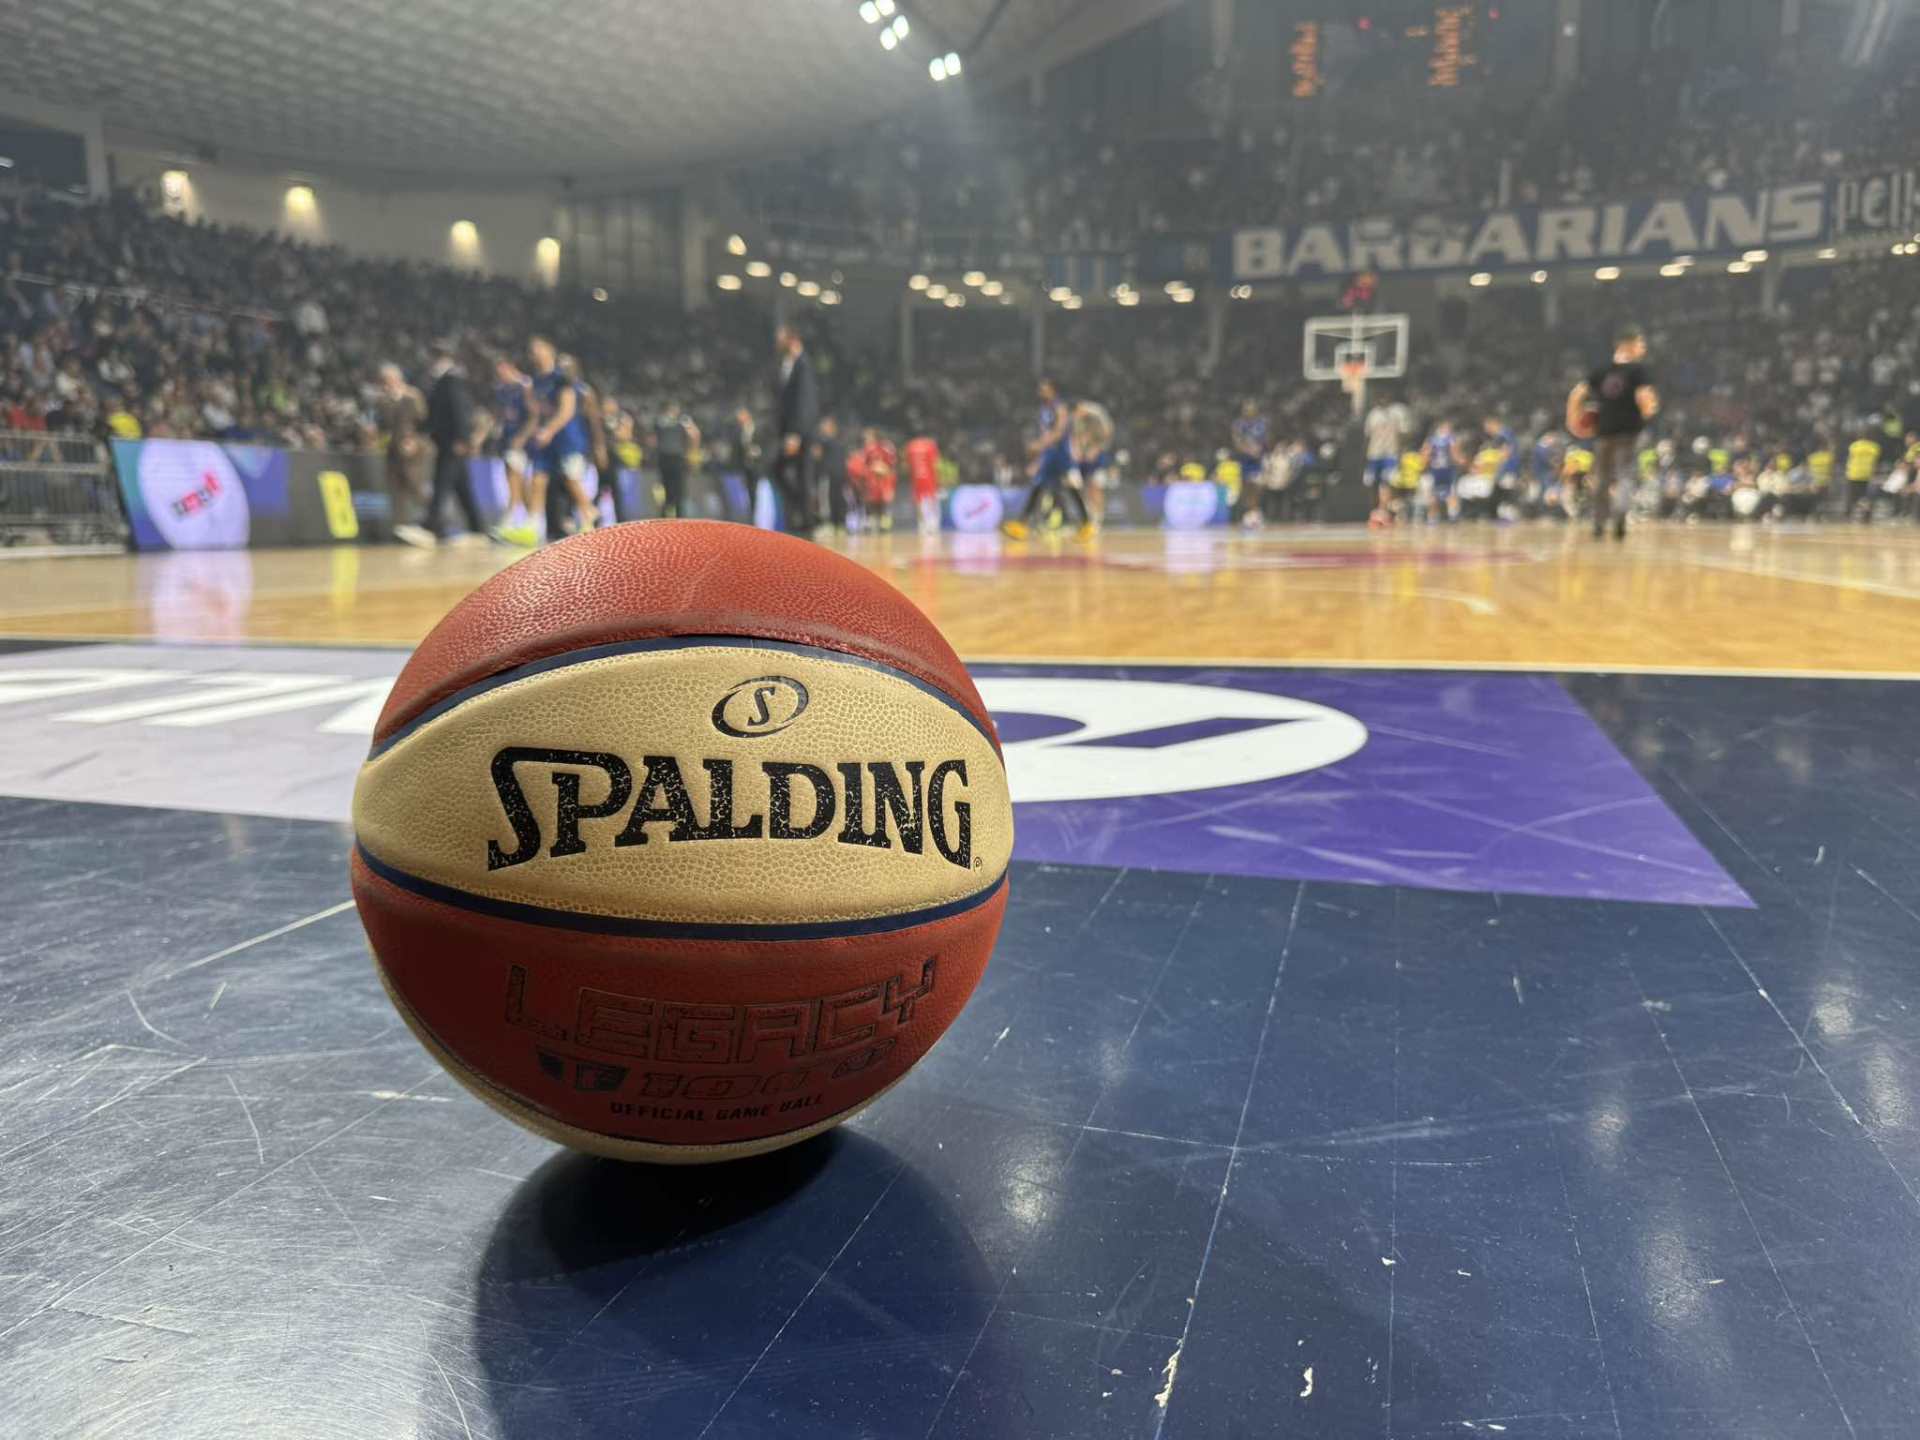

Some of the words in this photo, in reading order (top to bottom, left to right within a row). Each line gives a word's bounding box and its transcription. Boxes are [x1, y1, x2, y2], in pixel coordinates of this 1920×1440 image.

[1231, 181, 1826, 279] BARBARIANS
[746, 685, 775, 727] S
[488, 746, 971, 870] SPALDING
[504, 956, 937, 1065] LEGACY
[609, 1102, 705, 1122] OFFICIAL
[715, 1105, 769, 1121] GAME
[779, 1094, 823, 1114] BALL
